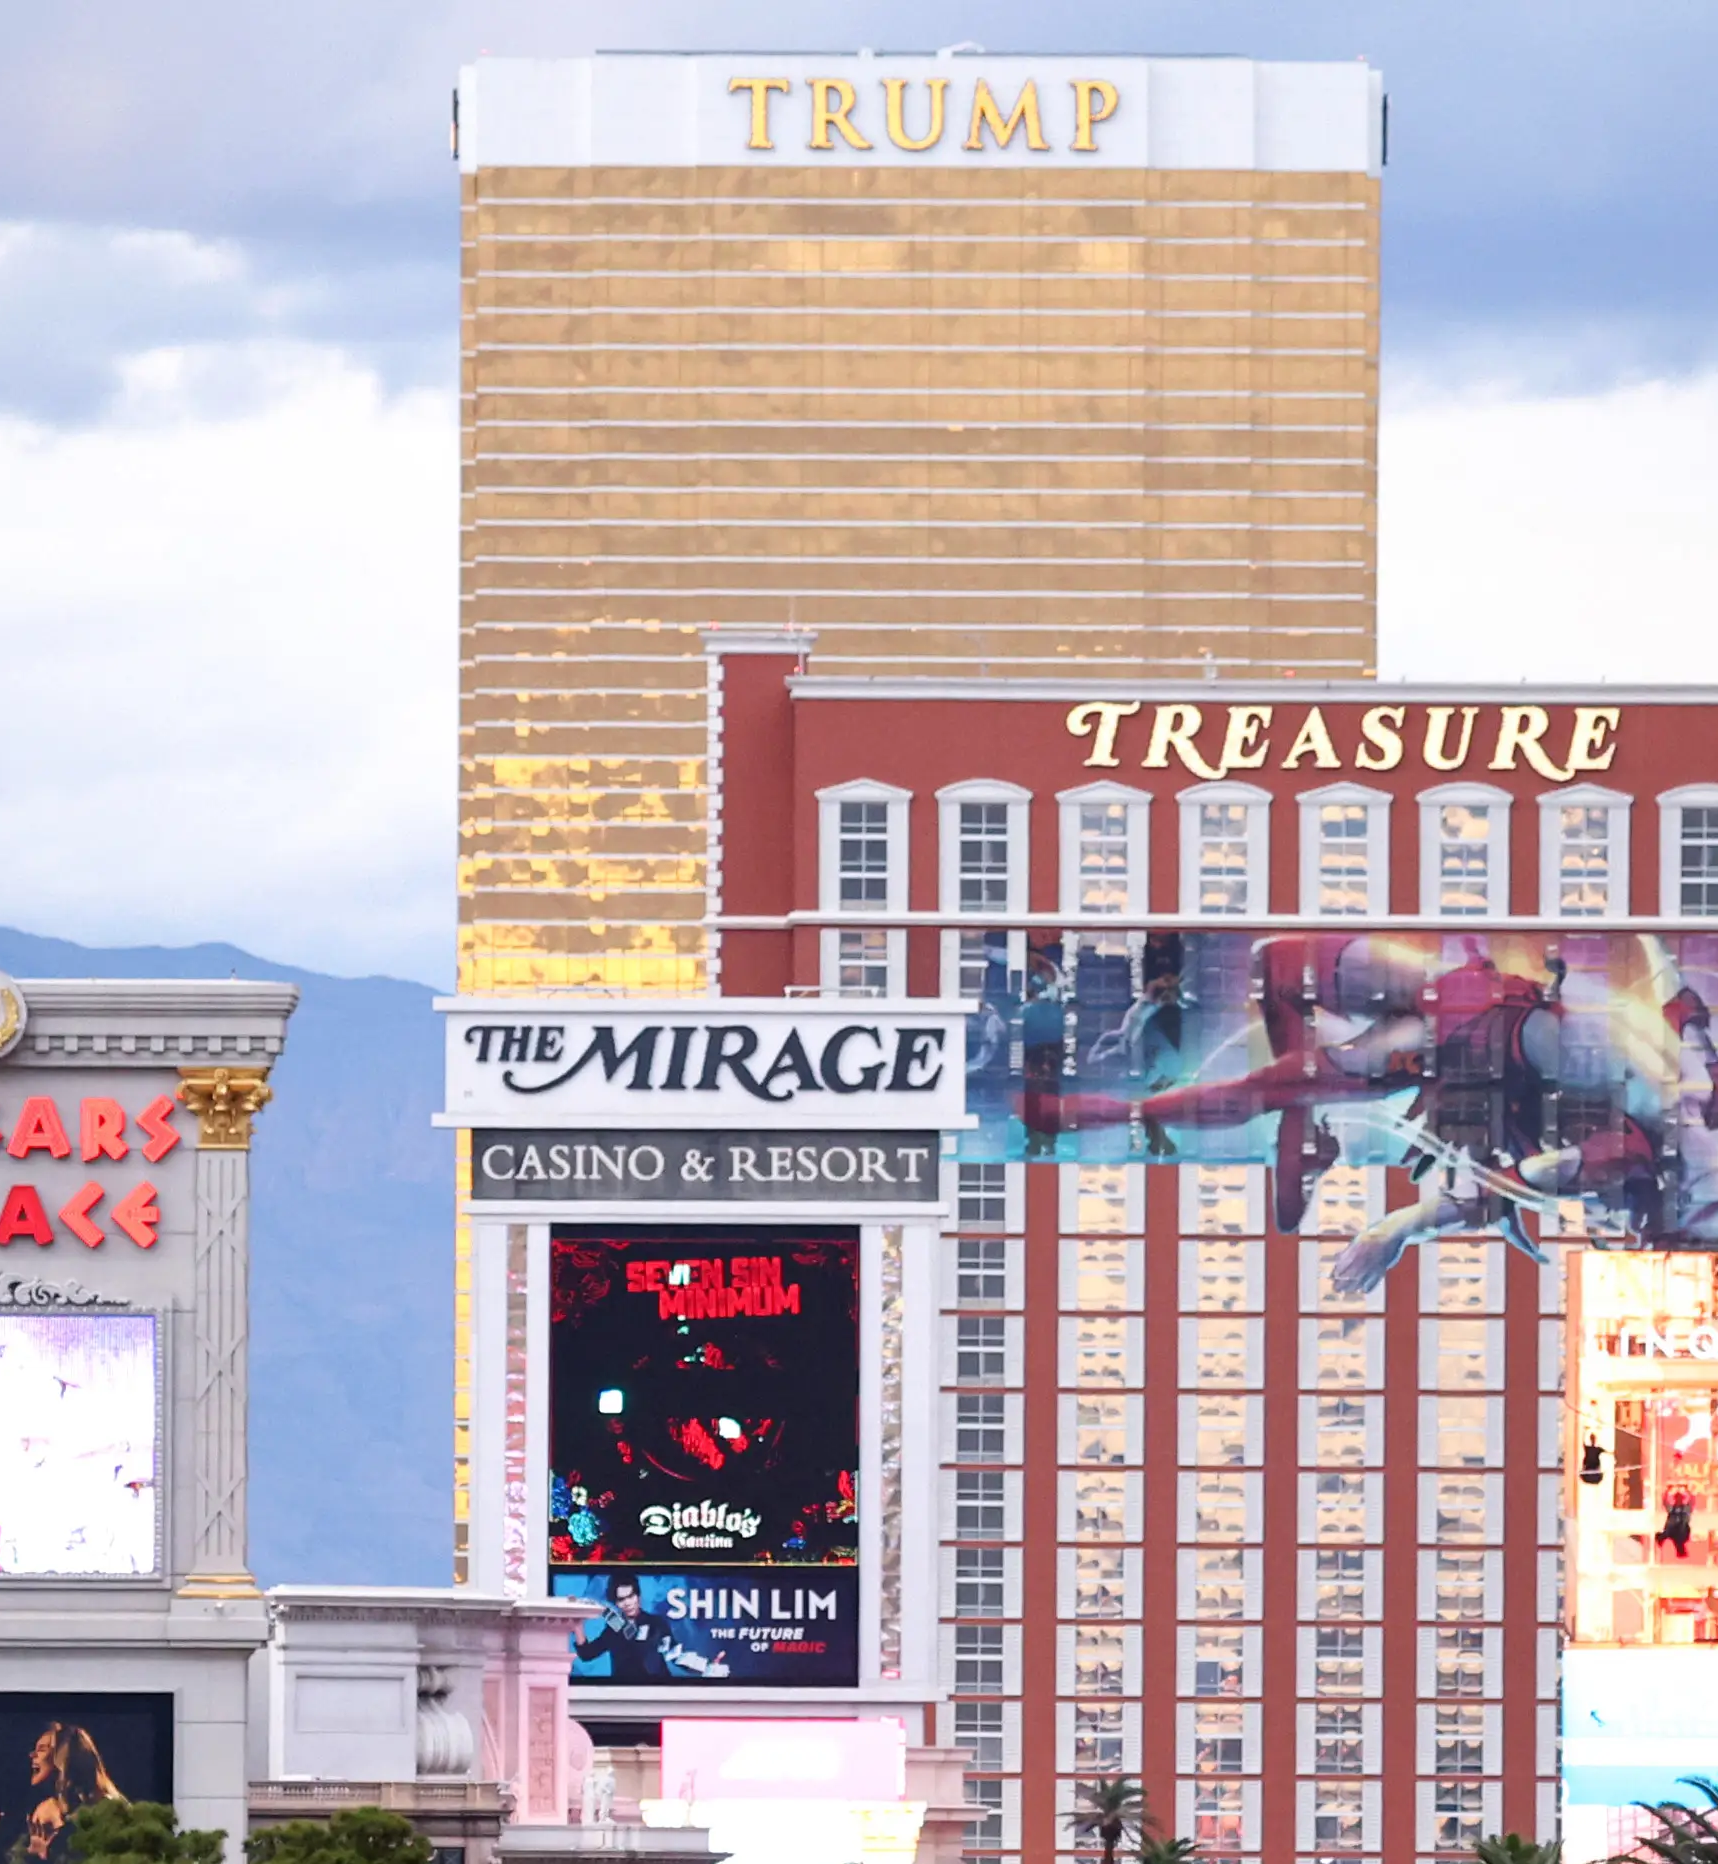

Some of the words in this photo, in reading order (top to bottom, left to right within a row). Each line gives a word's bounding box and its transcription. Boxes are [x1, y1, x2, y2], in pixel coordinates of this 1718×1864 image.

[728, 77, 1120, 153] TRUMP
[1066, 701, 1622, 781] TREASURE
[465, 1025, 564, 1063] THE
[503, 1025, 946, 1102] MIRAGE
[481, 1144, 665, 1182] CASINO
[680, 1146, 715, 1182] &
[728, 1146, 929, 1183] RESORT
[626, 1258, 723, 1293] SEVEN
[731, 1256, 782, 1291] SIN
[658, 1284, 800, 1319] MINIMUM
[639, 1499, 762, 1538] Diablo's
[666, 1587, 763, 1620] SHIN
[772, 1588, 837, 1620] LIM
[710, 1628, 735, 1639] THE
[738, 1627, 804, 1640] FUTURE
[750, 1642, 769, 1652] OF
[773, 1641, 826, 1653] MAGIC
